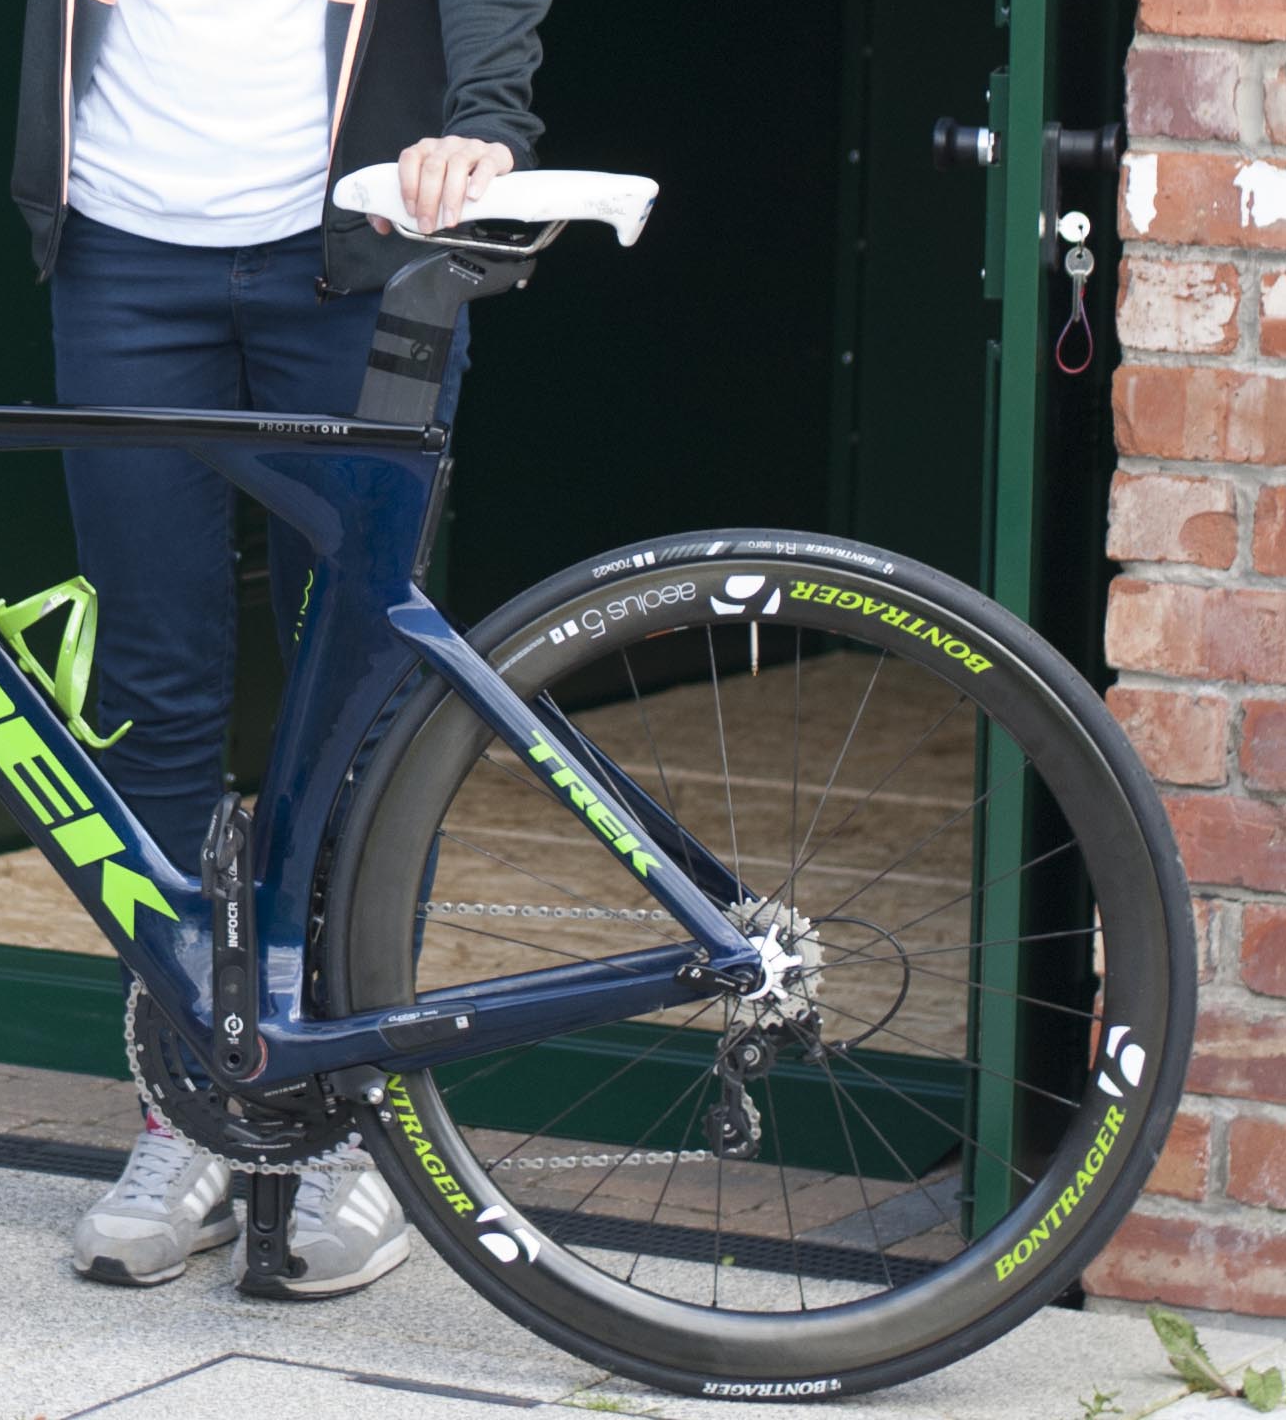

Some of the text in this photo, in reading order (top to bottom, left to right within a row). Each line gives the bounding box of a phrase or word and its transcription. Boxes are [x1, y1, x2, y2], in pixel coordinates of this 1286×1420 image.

[776, 542, 797, 555] R4
[805, 543, 876, 565] BONTRAGER
[581, 582, 696, 639] aeolus 5
[789, 581, 994, 674] BONTRAGER
[528, 730, 663, 878] TREK
[385, 1072, 475, 1218] NTRAGER
[994, 1105, 1126, 1282] BONTRAGER
[702, 1380, 827, 1396] BONTRAGER
